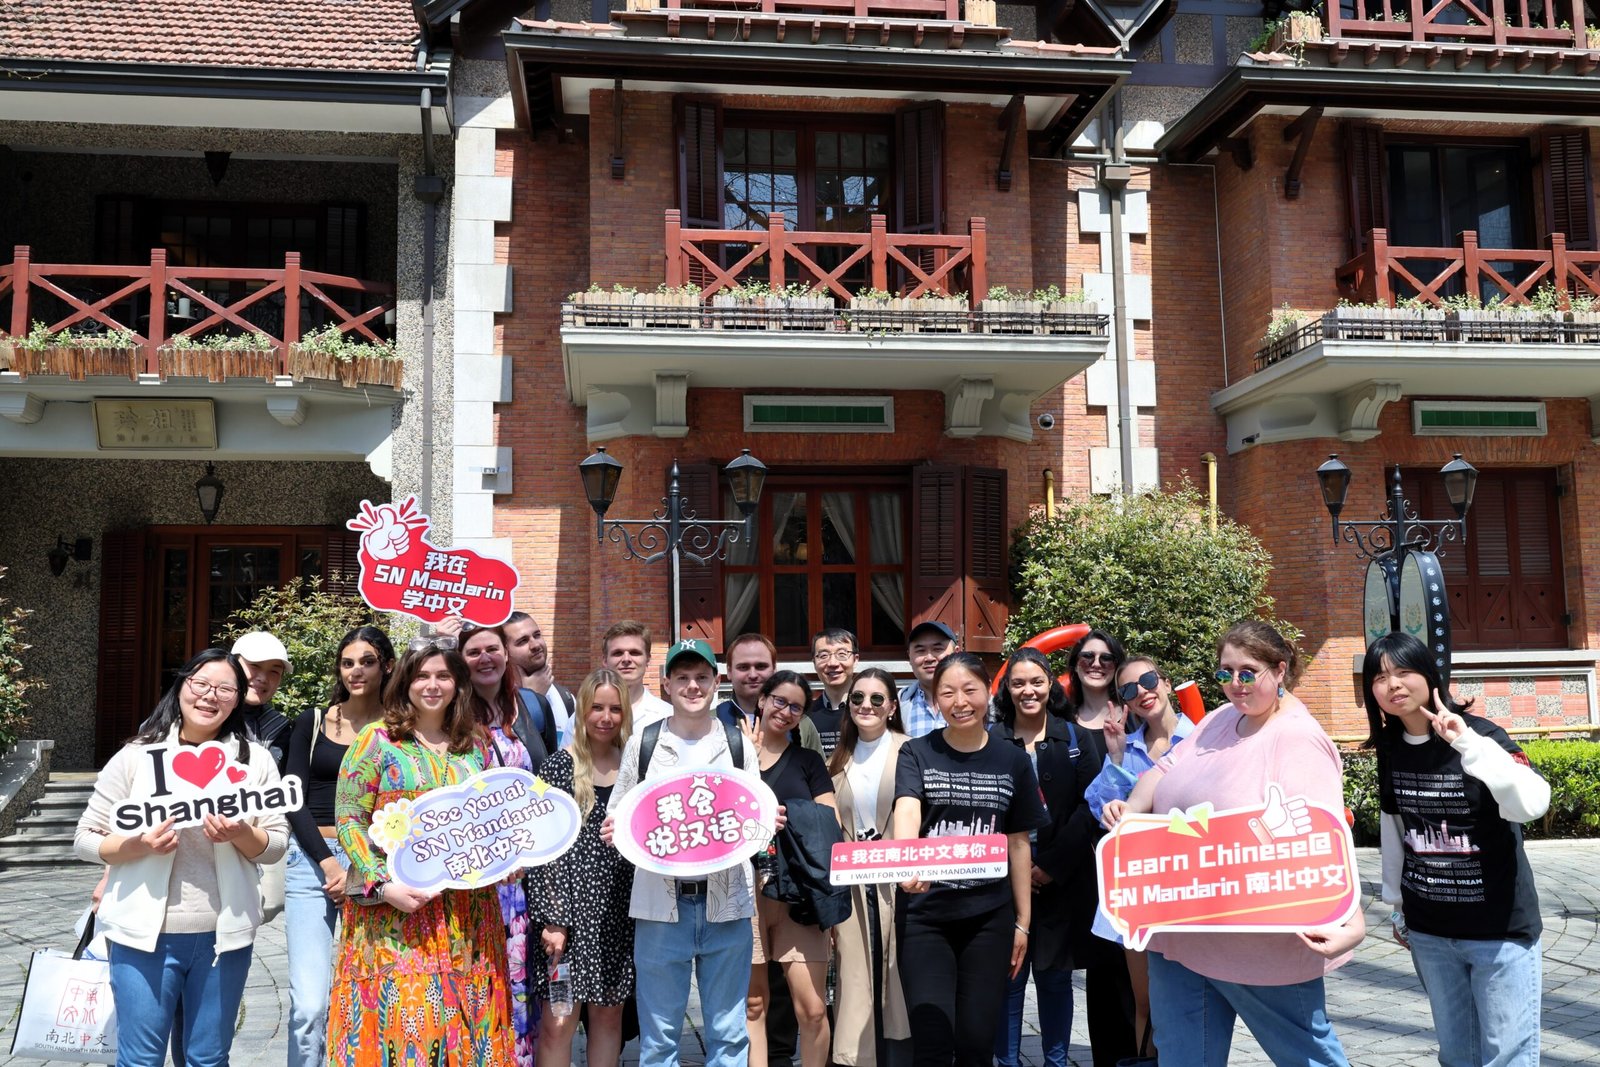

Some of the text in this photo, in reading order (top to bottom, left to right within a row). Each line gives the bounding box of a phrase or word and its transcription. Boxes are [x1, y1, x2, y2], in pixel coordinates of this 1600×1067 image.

[373, 564, 505, 601] SN Mandarin
[424, 551, 469, 576] 我在
[400, 589, 468, 617] 学中文
[147, 748, 172, 798] I
[116, 780, 297, 831] Shanghai
[420, 806, 462, 832] See
[504, 779, 527, 801] at
[655, 786, 717, 824] 我会
[411, 798, 554, 863] SN Mandarin
[644, 809, 742, 858] 说汉语
[444, 828, 535, 880] 南北中文
[839, 842, 999, 865] 东 我在南北中文等你 西
[855, 872, 876, 880] WAIT
[877, 871, 894, 879] FOR
[896, 870, 914, 878] YOU
[940, 867, 986, 876] MANDARIN
[1113, 831, 1332, 878] Learn Chinese@
[1109, 863, 1345, 908] SN Mandarin 南北中文
[34, 1042, 55, 1050] SOUTH
[45, 1028, 109, 1047] 南北中文
